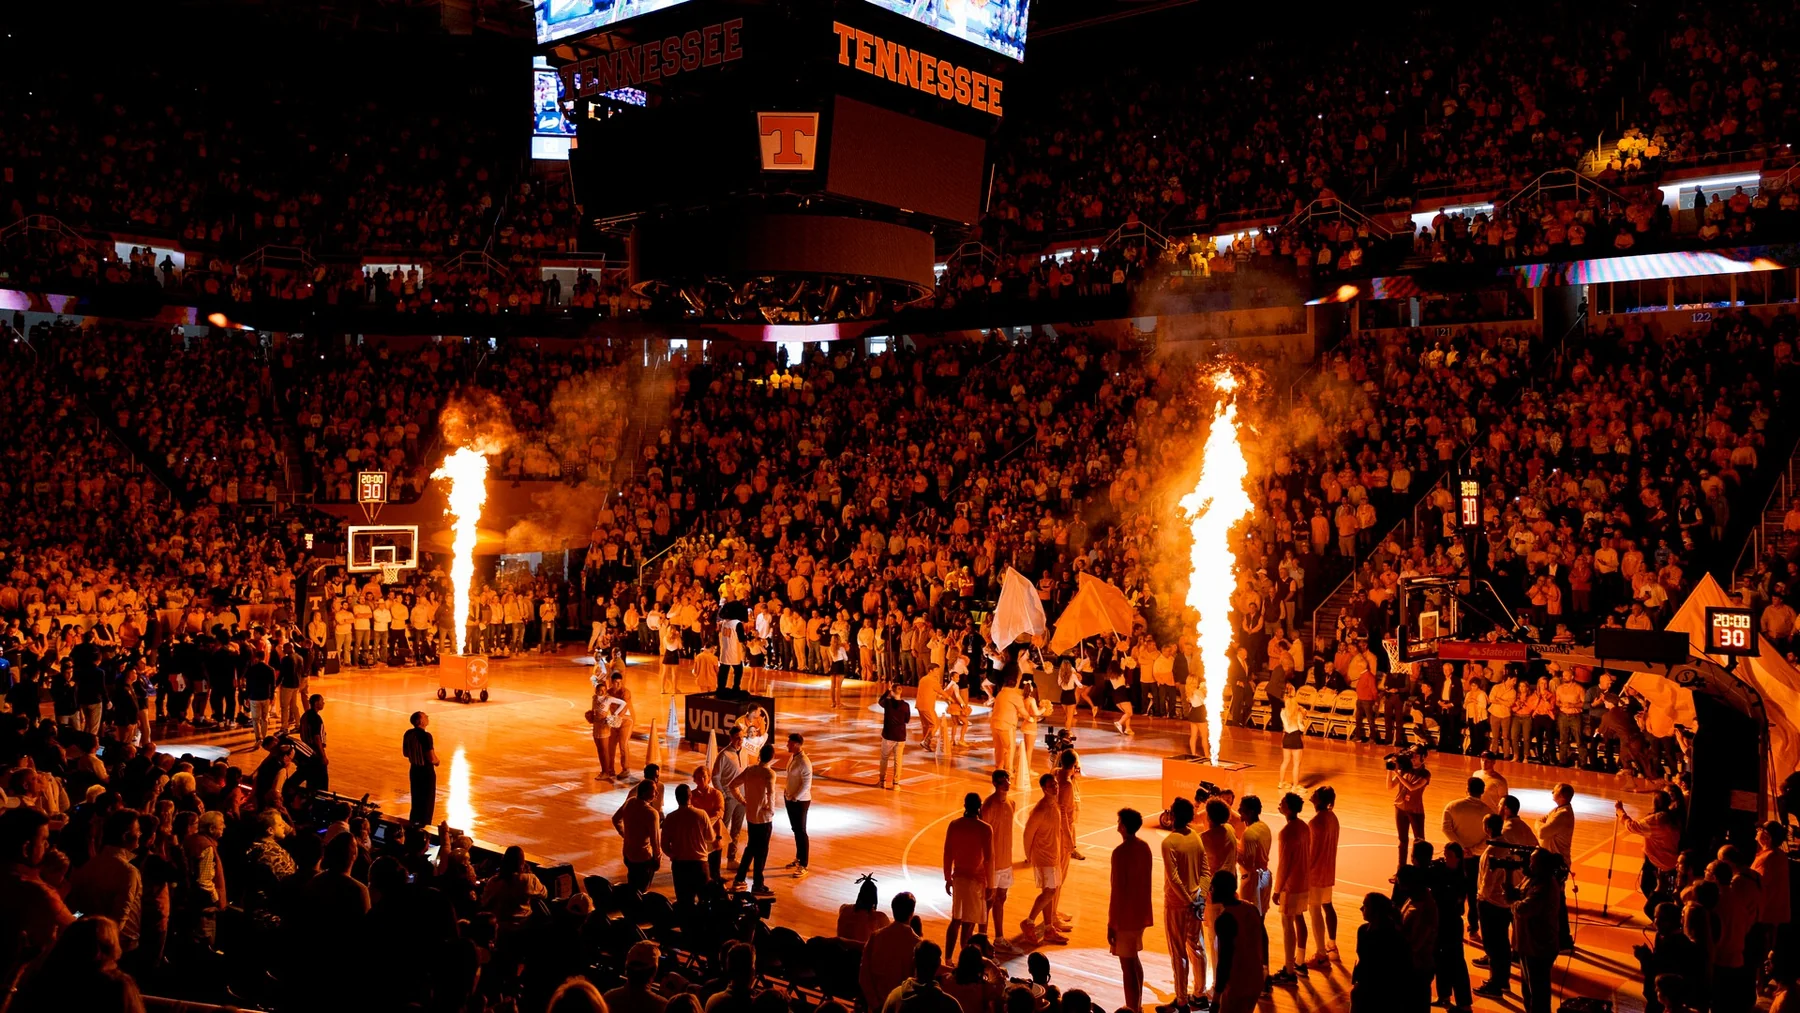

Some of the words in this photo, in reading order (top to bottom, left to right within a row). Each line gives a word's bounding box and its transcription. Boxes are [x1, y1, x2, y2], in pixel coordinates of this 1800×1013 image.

[560, 17, 744, 101] TENNESSEE
[833, 21, 1004, 117] TENNESSEE
[761, 115, 815, 164] T
[1691, 312, 1711, 323] 122
[1436, 327, 1450, 337] 121
[361, 475, 384, 484] 20:00
[363, 484, 381, 499] 30
[1462, 498, 1477, 524] 30
[1713, 613, 1750, 628] 20:00
[1721, 629, 1744, 647] 30
[688, 708, 736, 736] VOLS
